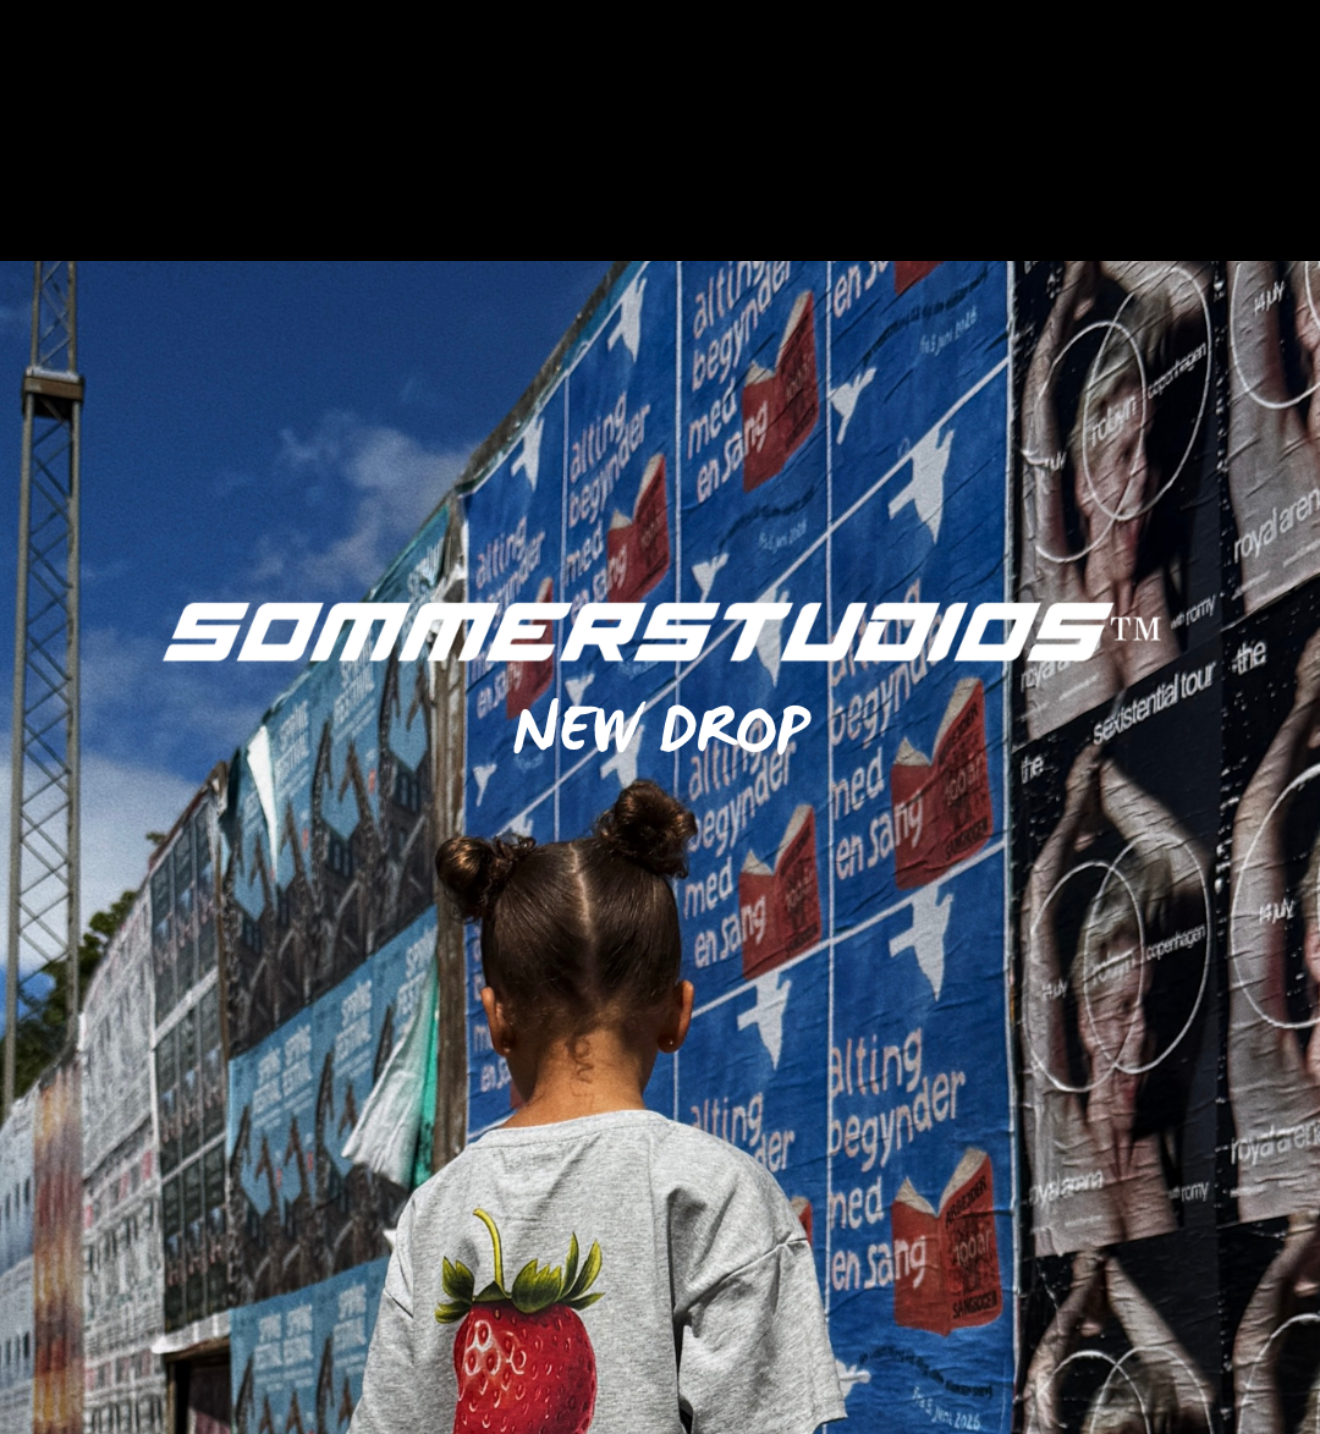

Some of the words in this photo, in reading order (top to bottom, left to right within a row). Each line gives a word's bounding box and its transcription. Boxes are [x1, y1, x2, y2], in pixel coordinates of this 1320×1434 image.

[570, 391, 628, 483] alting
[687, 377, 737, 461] med
[697, 459, 719, 504] en
[721, 400, 768, 484] sang
[568, 403, 651, 529] begynder
[1233, 506, 1278, 564] royal
[1279, 488, 1320, 534] aren
[1185, 594, 1217, 626] romy
[1020, 753, 1045, 785] the
[1092, 672, 1180, 745] sexistential
[1179, 660, 1217, 699] tour
[835, 835, 864, 881] en
[866, 788, 924, 868] sang
[682, 855, 735, 921] med
[694, 930, 718, 969] en
[719, 894, 766, 960] sang
[1145, 922, 1207, 962] copenhagen
[829, 1027, 922, 1099] alting
[1181, 1180, 1210, 1203] romy
[831, 1249, 861, 1292] en
[863, 1235, 927, 1289] sang
[953, 1411, 982, 1431] 2026
